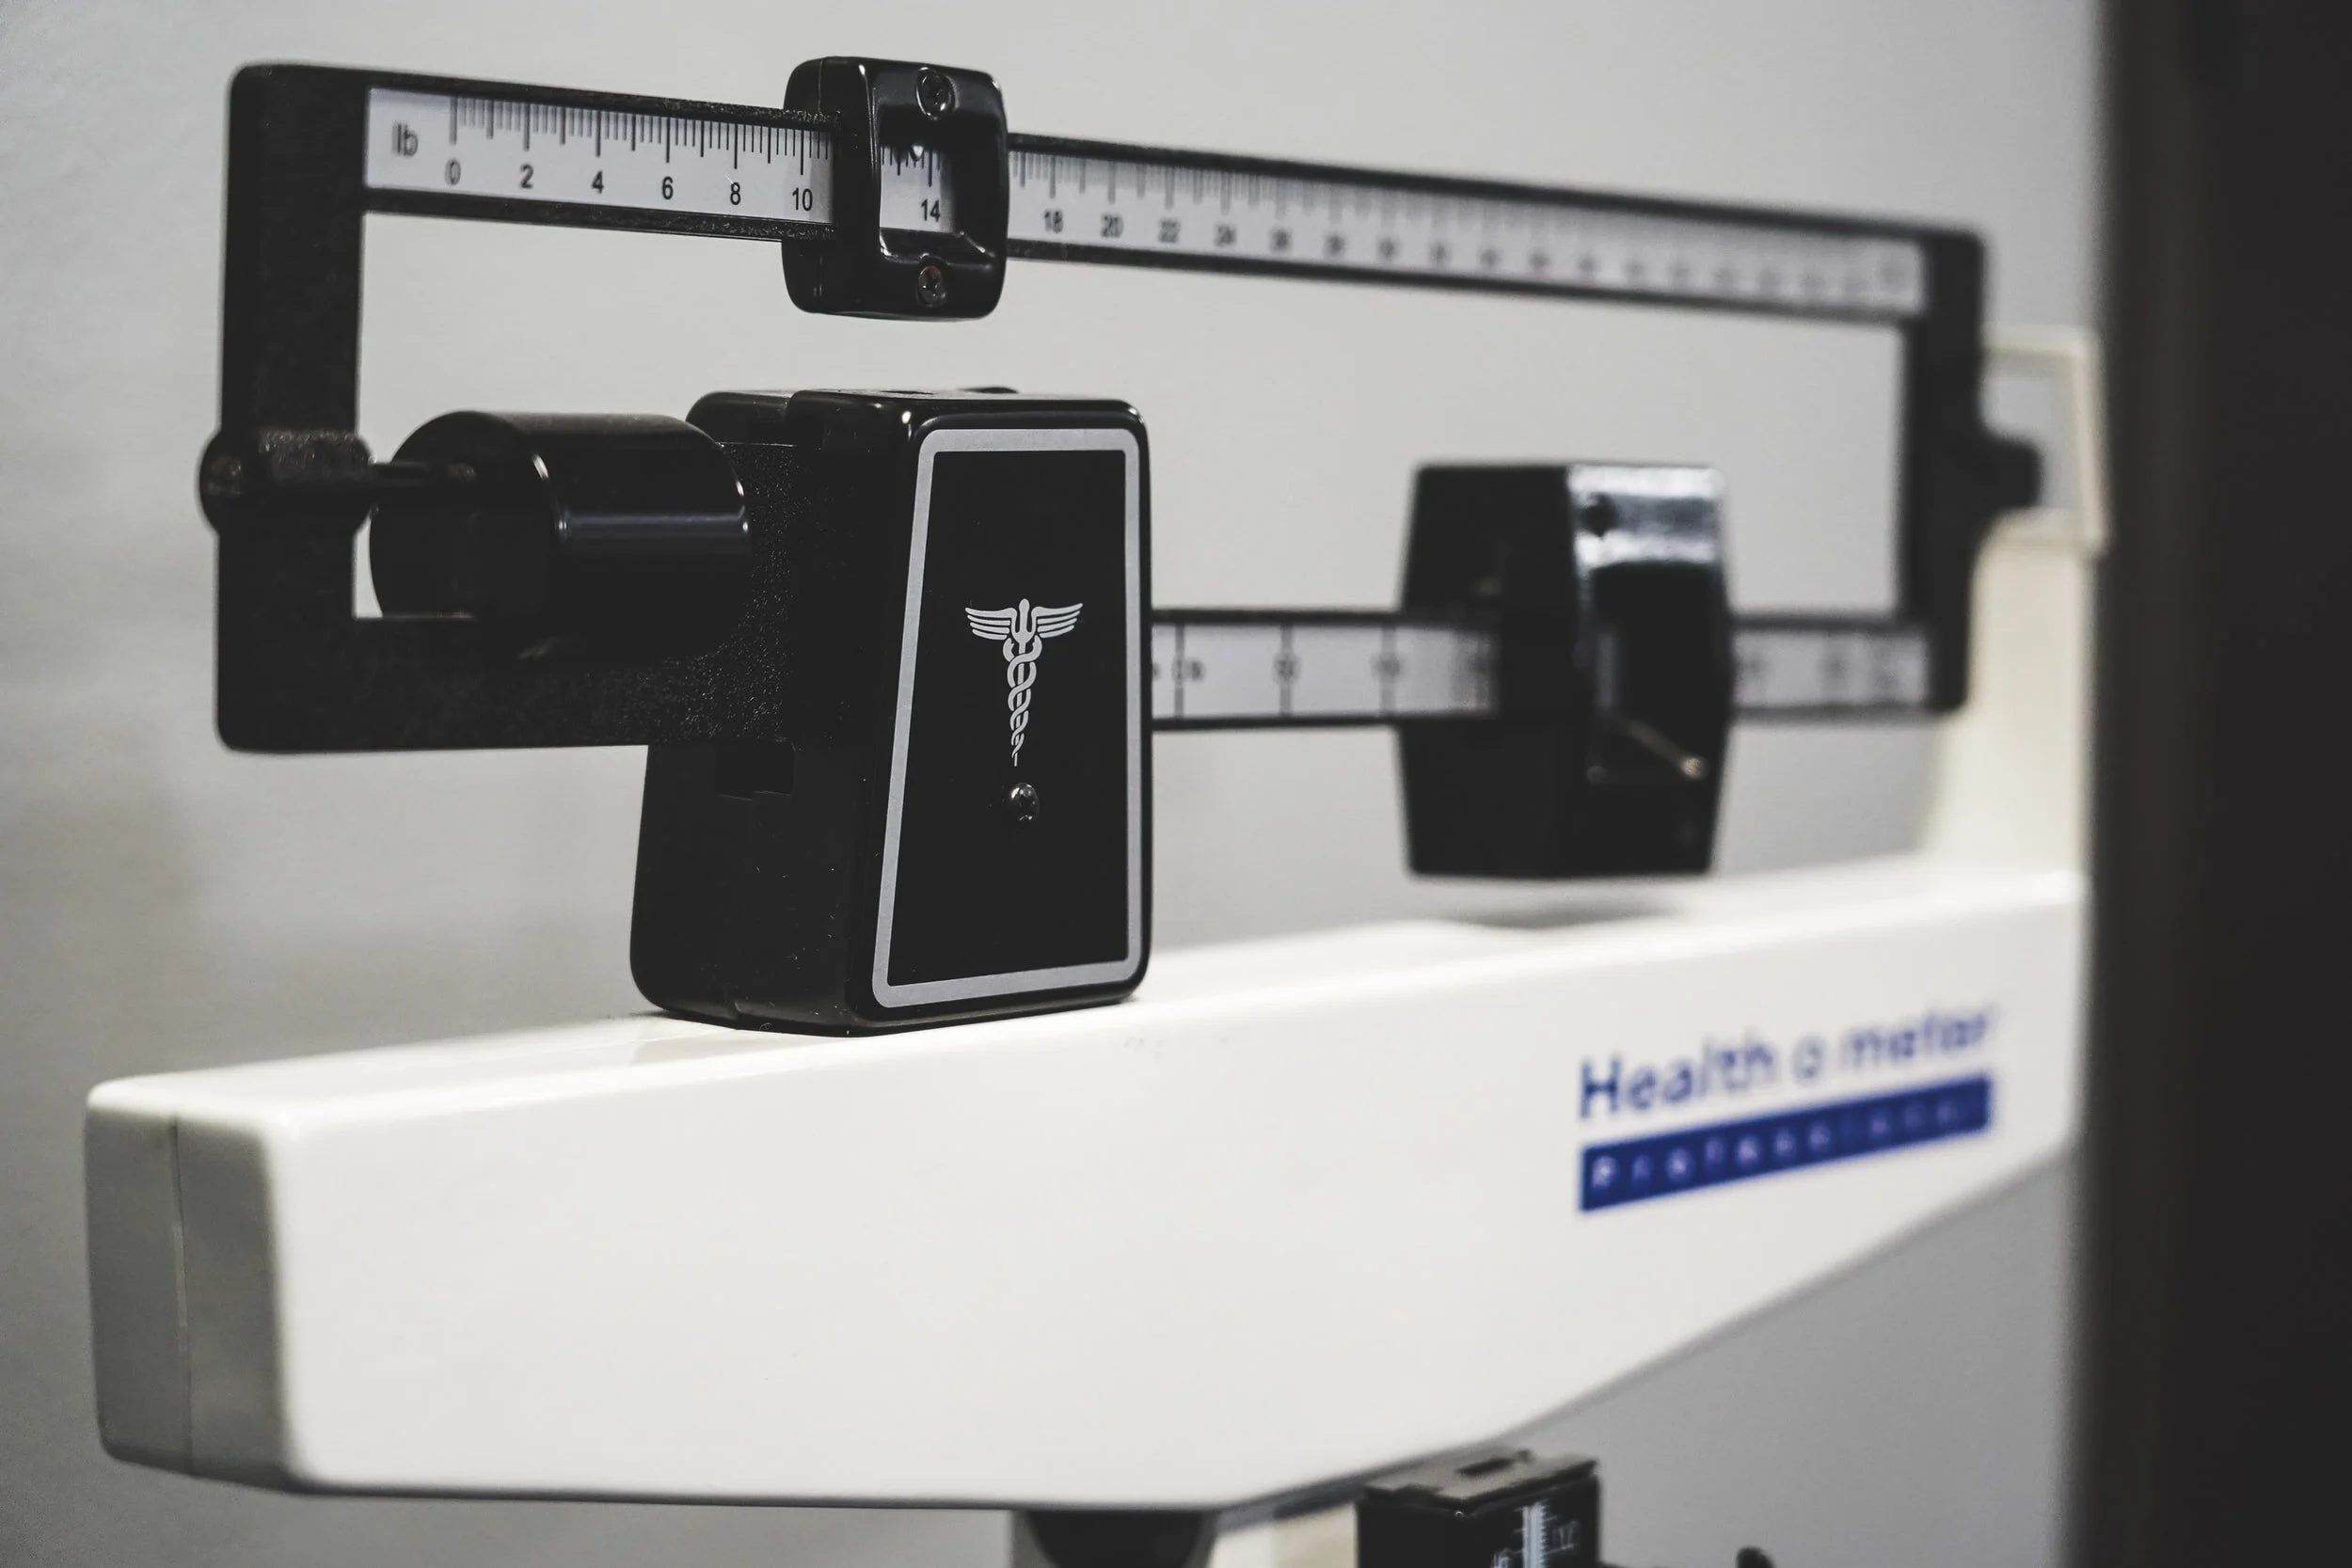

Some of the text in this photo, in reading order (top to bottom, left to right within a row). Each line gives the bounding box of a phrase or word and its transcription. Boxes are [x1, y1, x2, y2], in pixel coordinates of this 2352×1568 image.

[392, 121, 419, 157] lb
[445, 159, 461, 185] 0
[519, 165, 534, 189] 2
[591, 170, 605, 195] 4
[661, 176, 675, 200] 6
[729, 182, 742, 206] 8
[791, 188, 814, 212] 10
[920, 198, 942, 222] 14
[1042, 210, 1064, 234] 18
[1101, 214, 1123, 238] 20
[1158, 218, 1182, 244] 22
[1581, 1009, 1990, 1118] Health o meter
